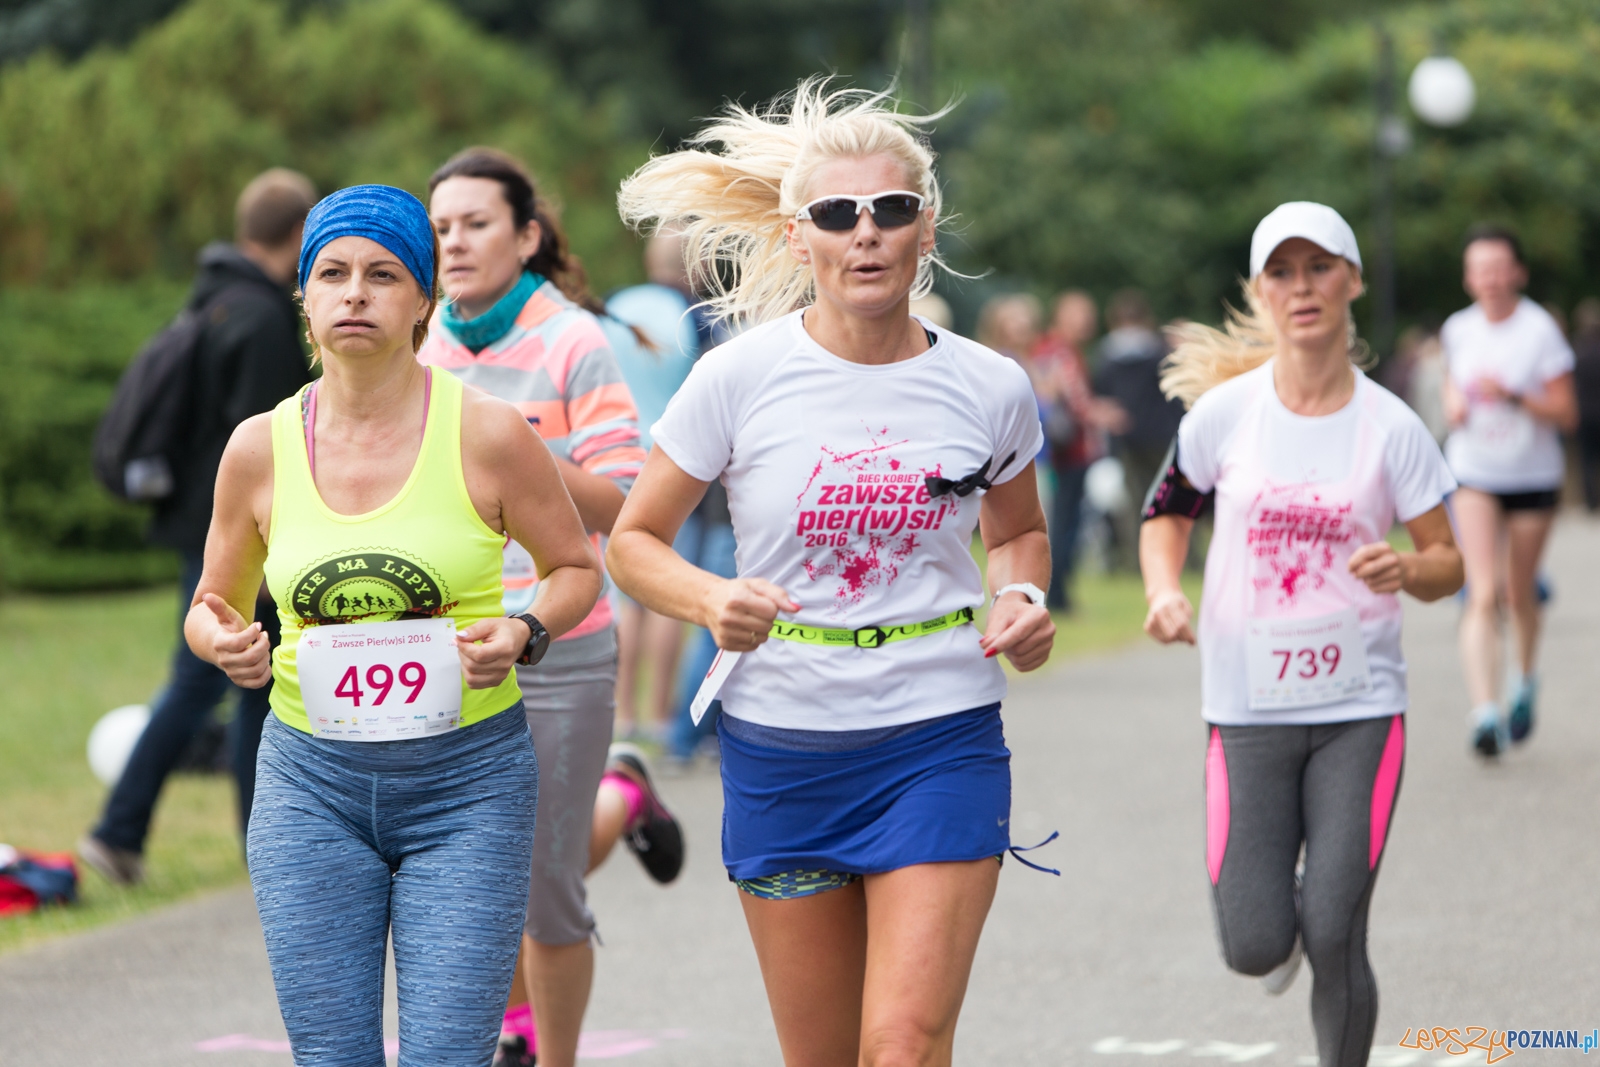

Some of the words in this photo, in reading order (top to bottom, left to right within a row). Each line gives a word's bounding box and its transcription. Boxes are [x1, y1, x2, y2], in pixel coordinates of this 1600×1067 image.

[856, 474, 881, 484] BIEG
[882, 473, 921, 484] KOBIET
[817, 484, 932, 506] zawsze
[804, 531, 849, 548] 2016
[297, 571, 327, 605] NIE
[336, 558, 369, 573] MA
[380, 559, 432, 595] LIPY
[332, 639, 365, 649] Zawsze
[366, 637, 406, 648] Pier(w)si
[407, 633, 432, 644] 2016
[1272, 643, 1343, 682] 739
[334, 661, 427, 708] 499
